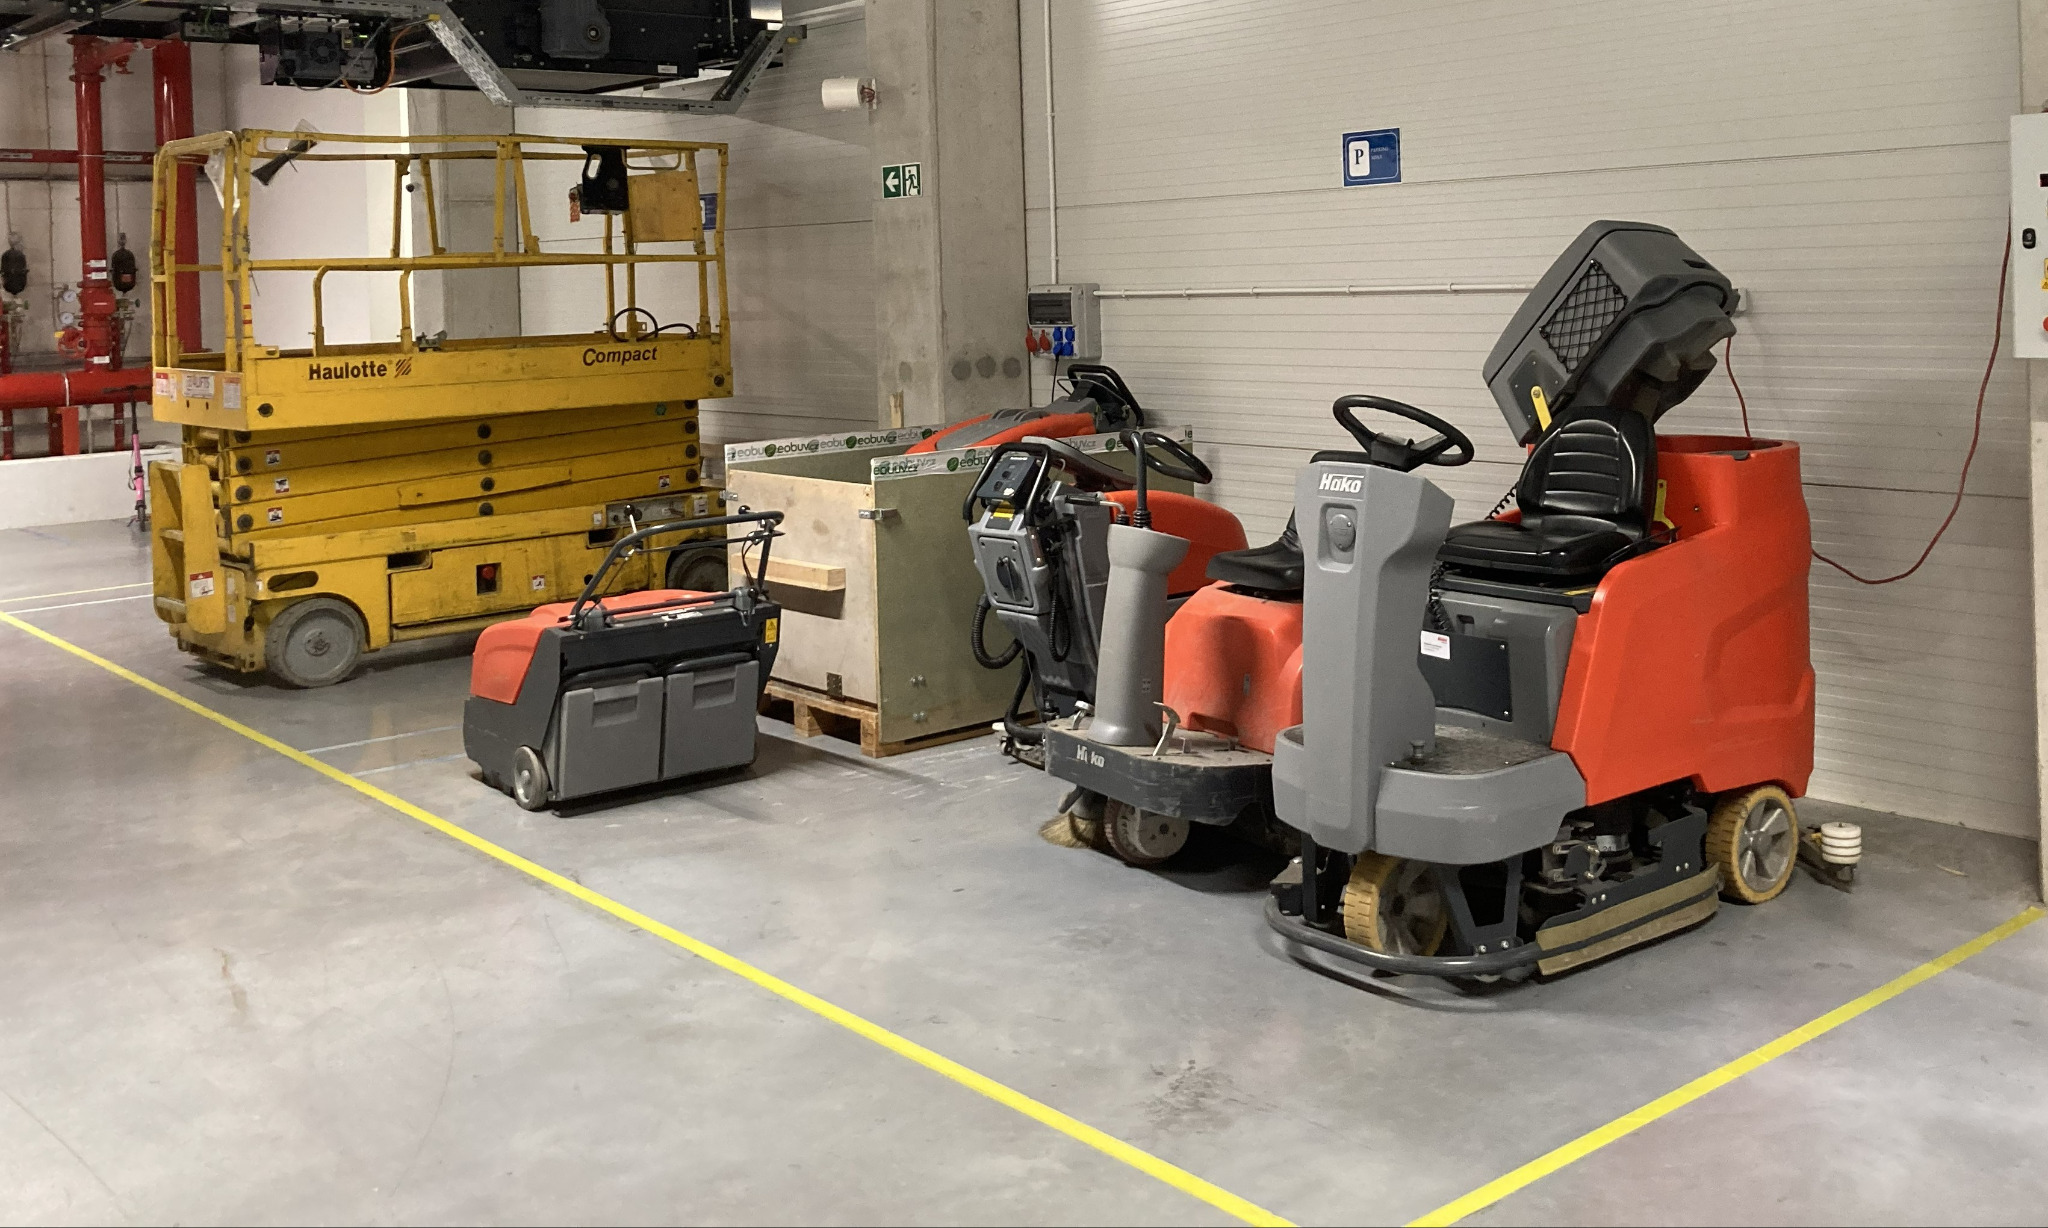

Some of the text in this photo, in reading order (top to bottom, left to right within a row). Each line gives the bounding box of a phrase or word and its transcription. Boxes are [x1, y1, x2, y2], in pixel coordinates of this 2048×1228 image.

[1354, 148, 1365, 165] P
[582, 346, 658, 367] Compact
[308, 360, 388, 380] Haulotte
[1318, 472, 1365, 493] Hako
